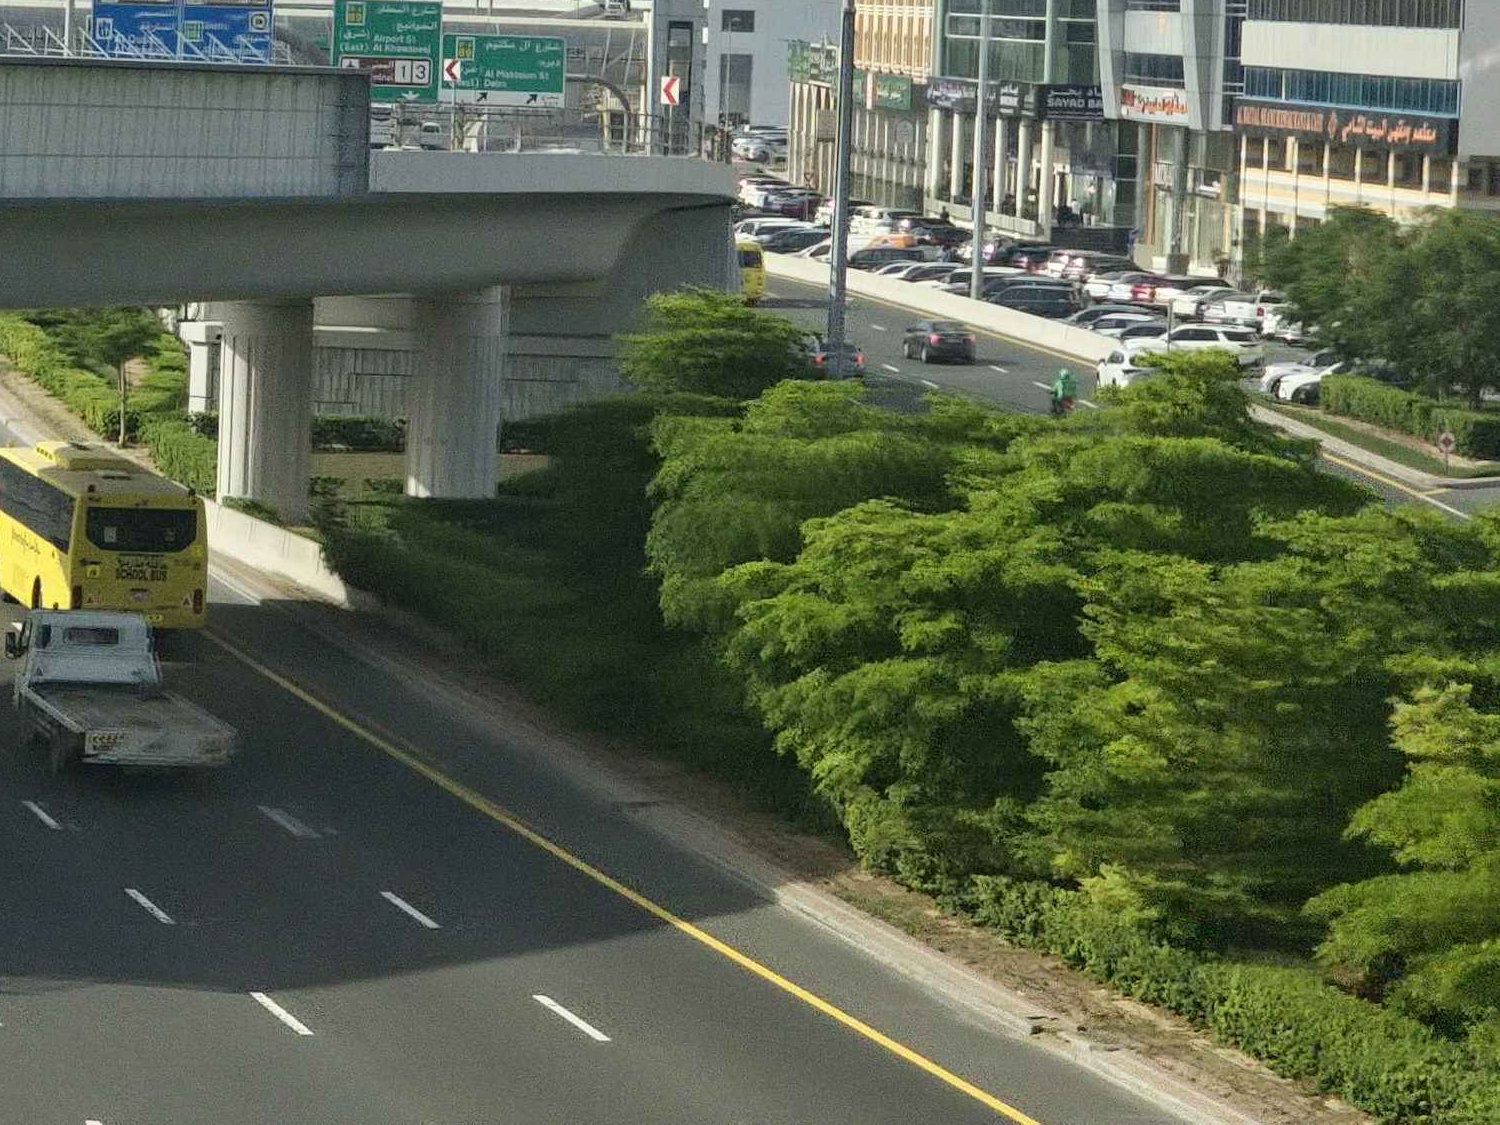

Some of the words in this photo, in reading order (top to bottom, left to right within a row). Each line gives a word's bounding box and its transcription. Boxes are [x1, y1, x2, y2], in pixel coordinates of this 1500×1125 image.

[373, 34, 404, 44] Airport
[415, 65, 426, 79] 3
[1047, 97, 1085, 108] SAYAD
